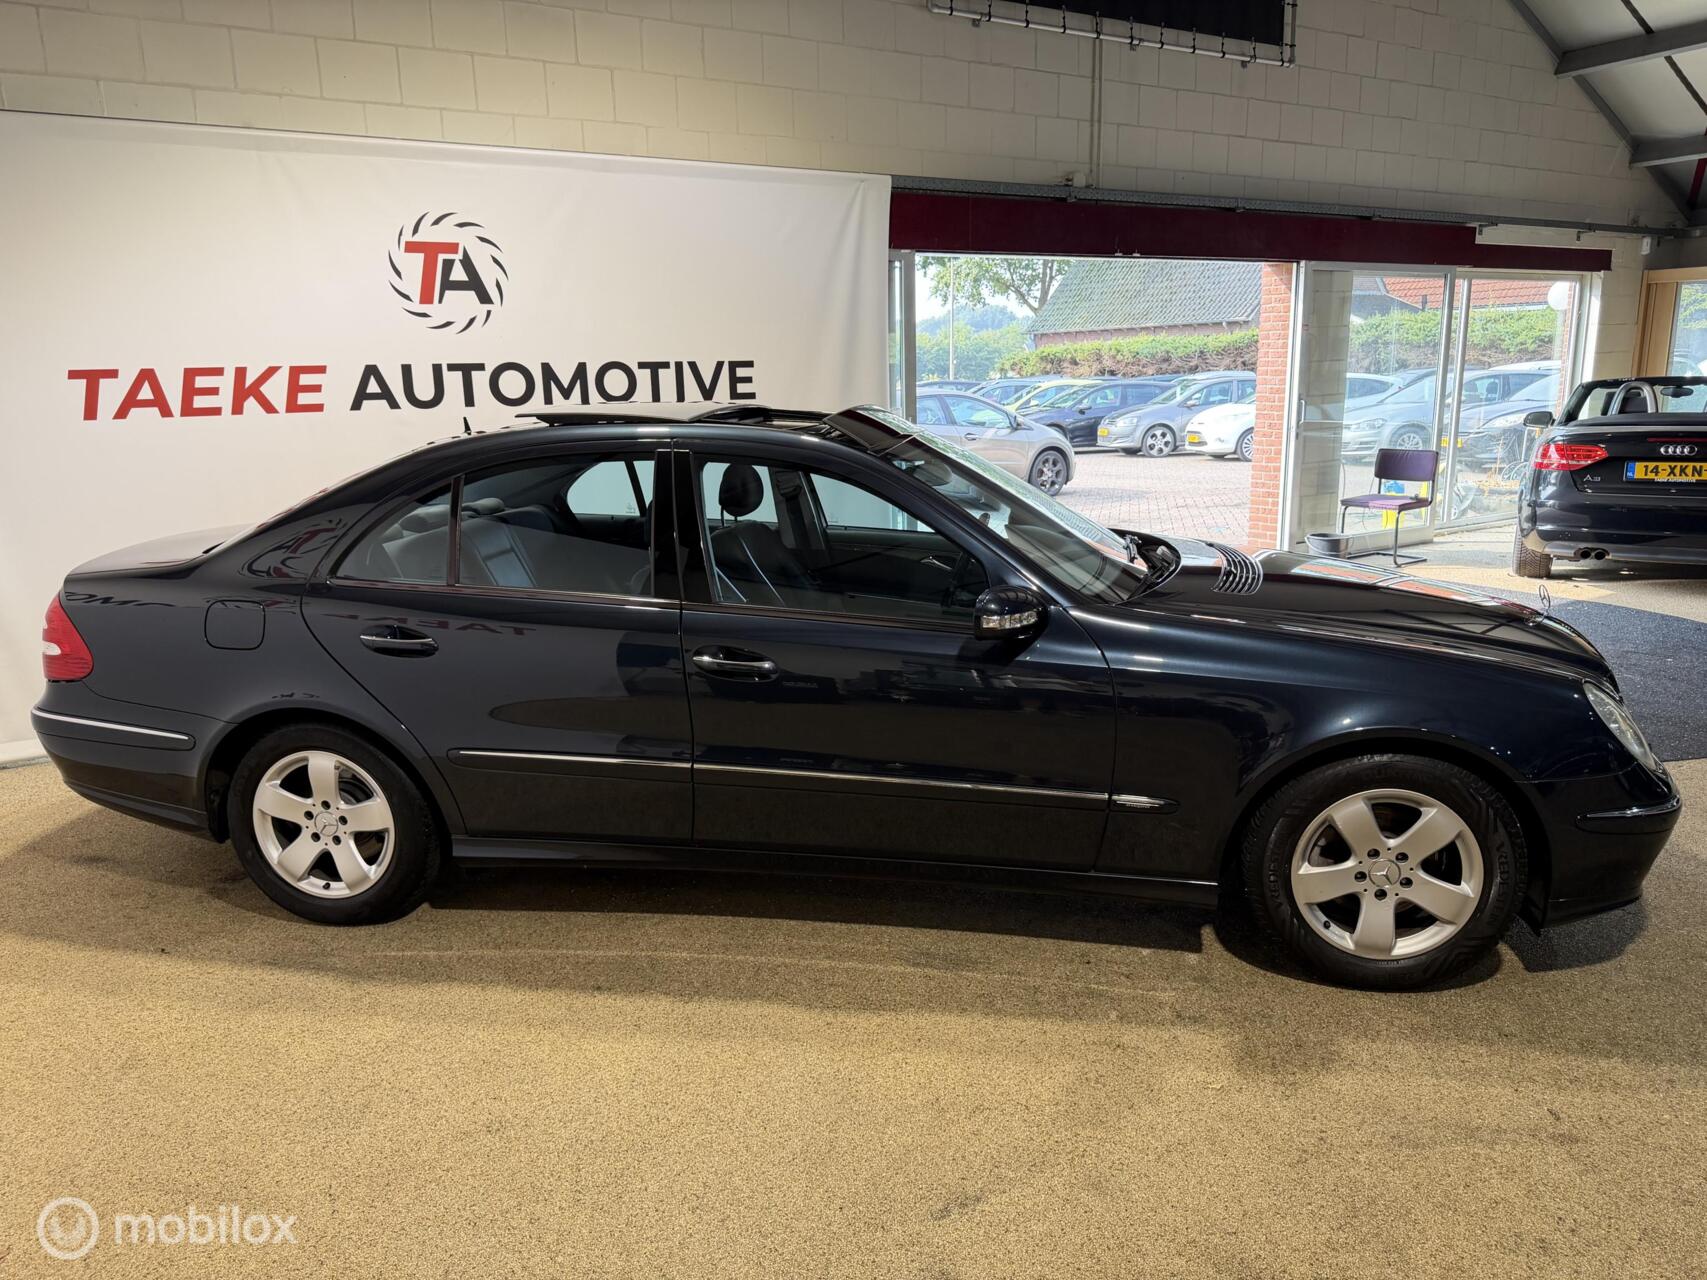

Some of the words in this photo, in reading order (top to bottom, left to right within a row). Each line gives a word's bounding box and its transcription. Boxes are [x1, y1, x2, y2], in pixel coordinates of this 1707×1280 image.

[404, 241, 495, 305] TA
[67, 365, 327, 421] TAEKE
[350, 360, 757, 411] AUTOMOTIVE
